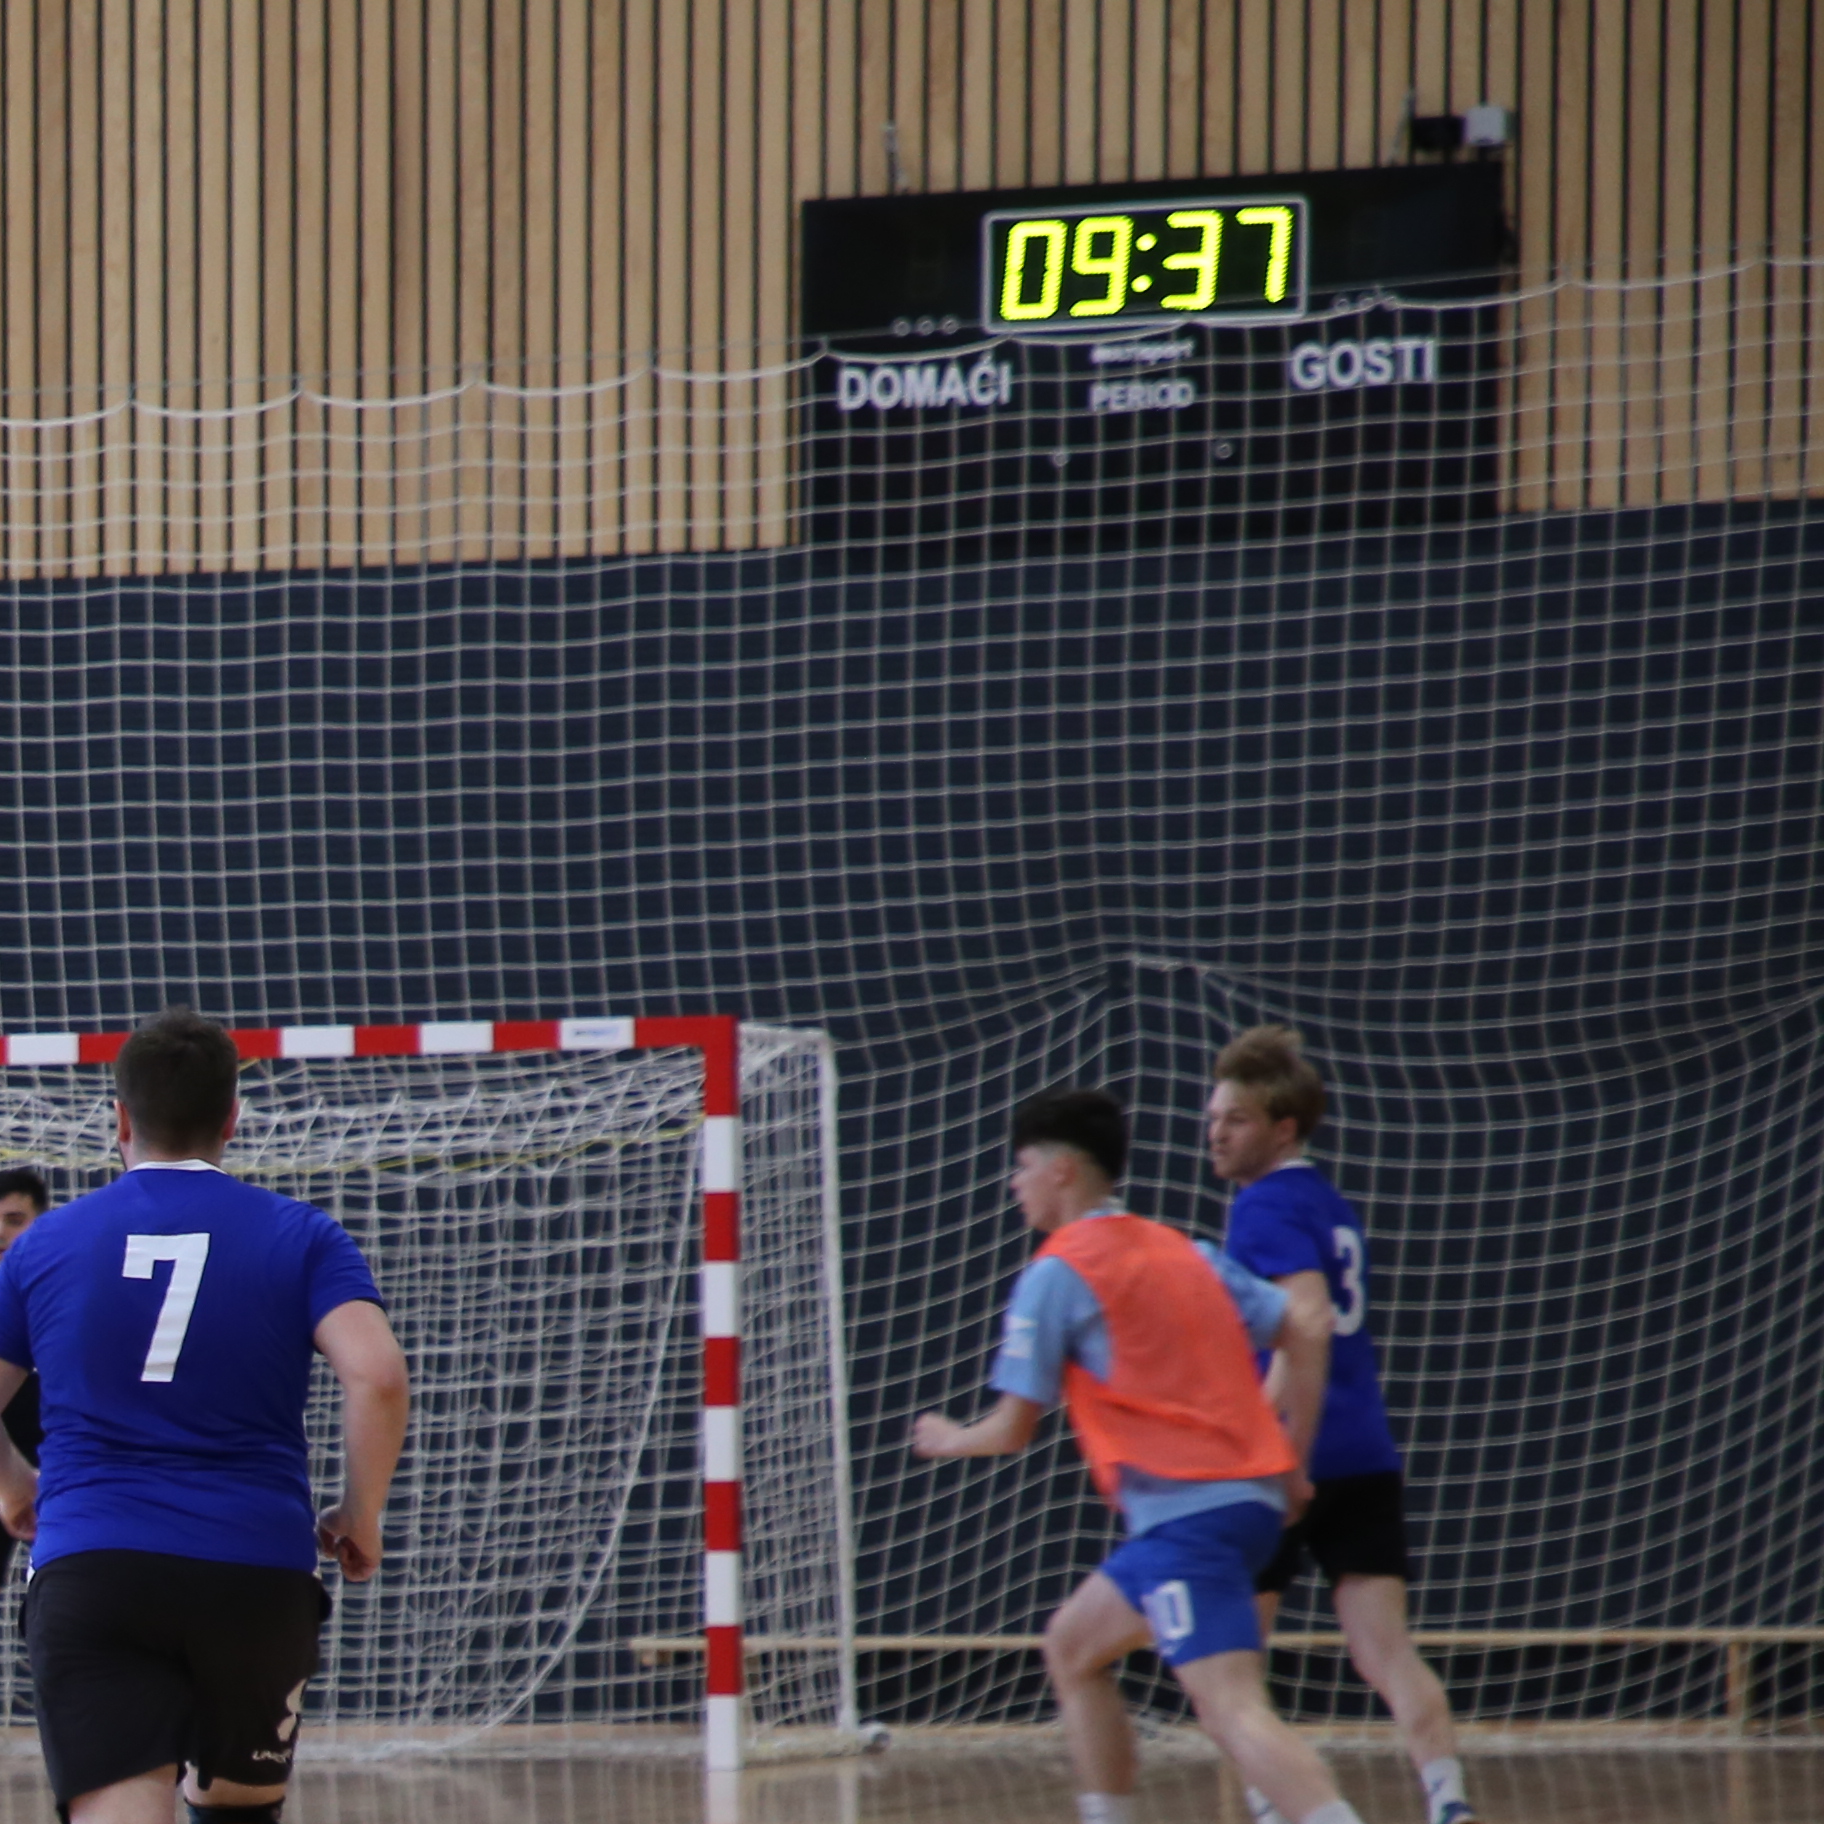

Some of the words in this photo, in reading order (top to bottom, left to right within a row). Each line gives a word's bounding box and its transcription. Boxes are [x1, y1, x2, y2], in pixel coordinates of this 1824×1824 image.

[999, 205, 1294, 321] 09:37
[838, 350, 1012, 411] DOMAĆI
[1091, 379, 1196, 414] PERIOD
[1291, 338, 1436, 391] GOSTI
[123, 1232, 210, 1383] 7
[1332, 1224, 1365, 1337] 3
